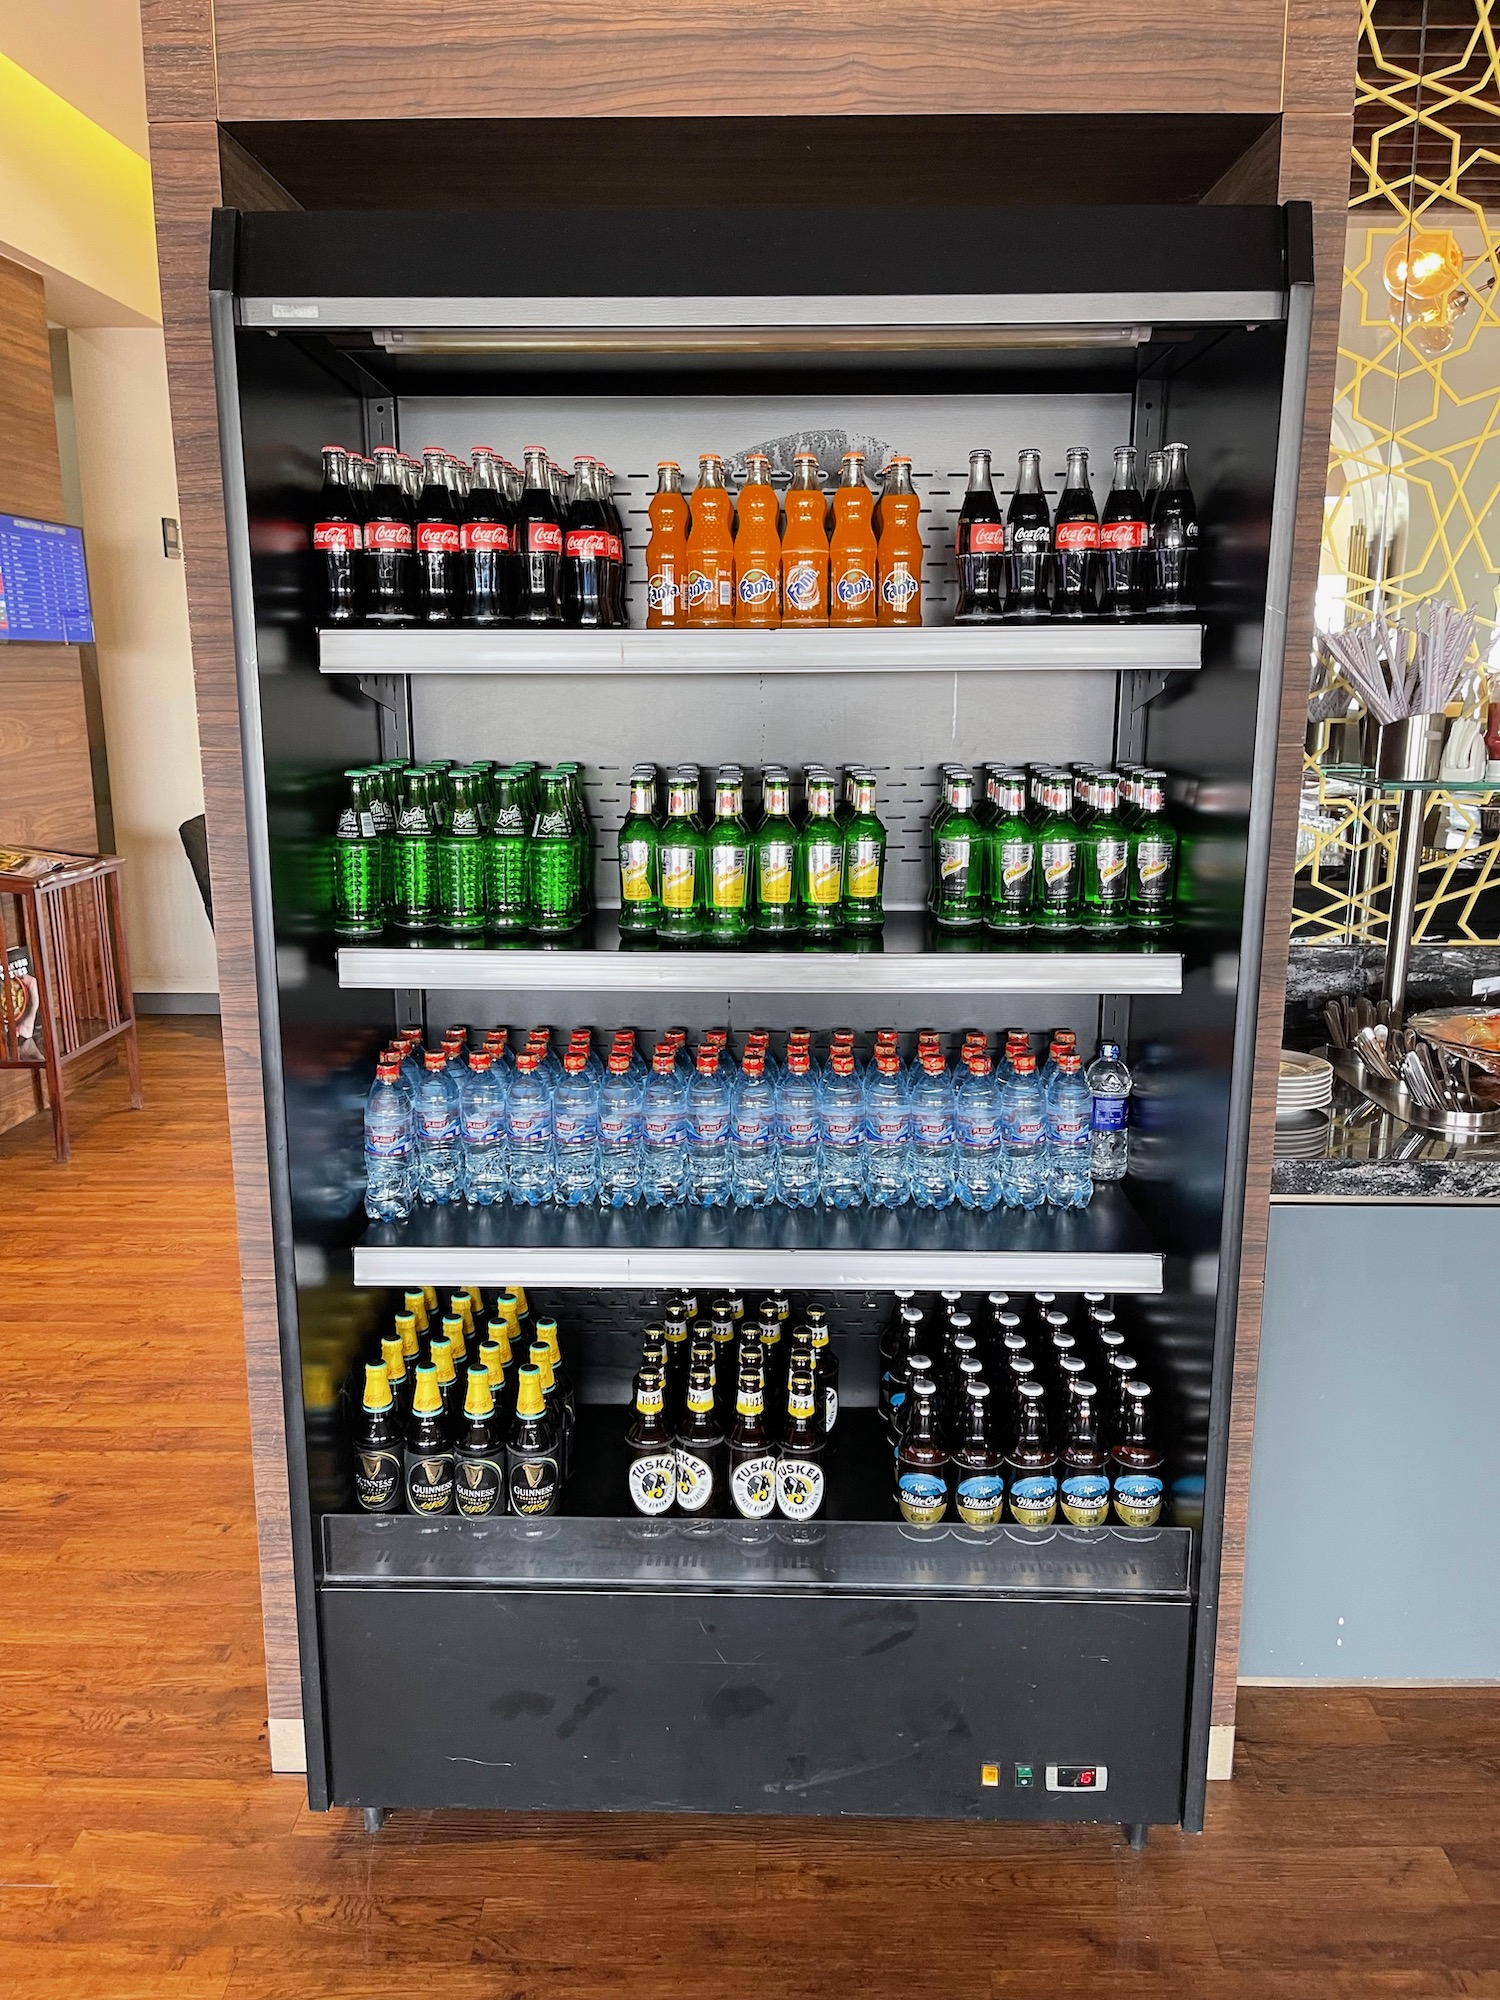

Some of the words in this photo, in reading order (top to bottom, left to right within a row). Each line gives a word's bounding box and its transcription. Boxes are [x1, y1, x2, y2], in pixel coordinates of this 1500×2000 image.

[567, 535, 605, 551] Coca-Cola
[1057, 526, 1096, 543] Coca-Cola
[688, 577, 713, 600] anta
[740, 576, 775, 602] Fanta
[786, 569, 818, 604] Fanta
[838, 576, 873, 602] Fanta
[883, 578, 917, 603] Fanta
[736, 1459, 775, 1483] TUSKE
[777, 1464, 821, 1484] TUSKER
[412, 1479, 454, 1495] GUINNESS
[456, 1483, 497, 1499] GUINNESS
[513, 1483, 555, 1497] GUINNESS
